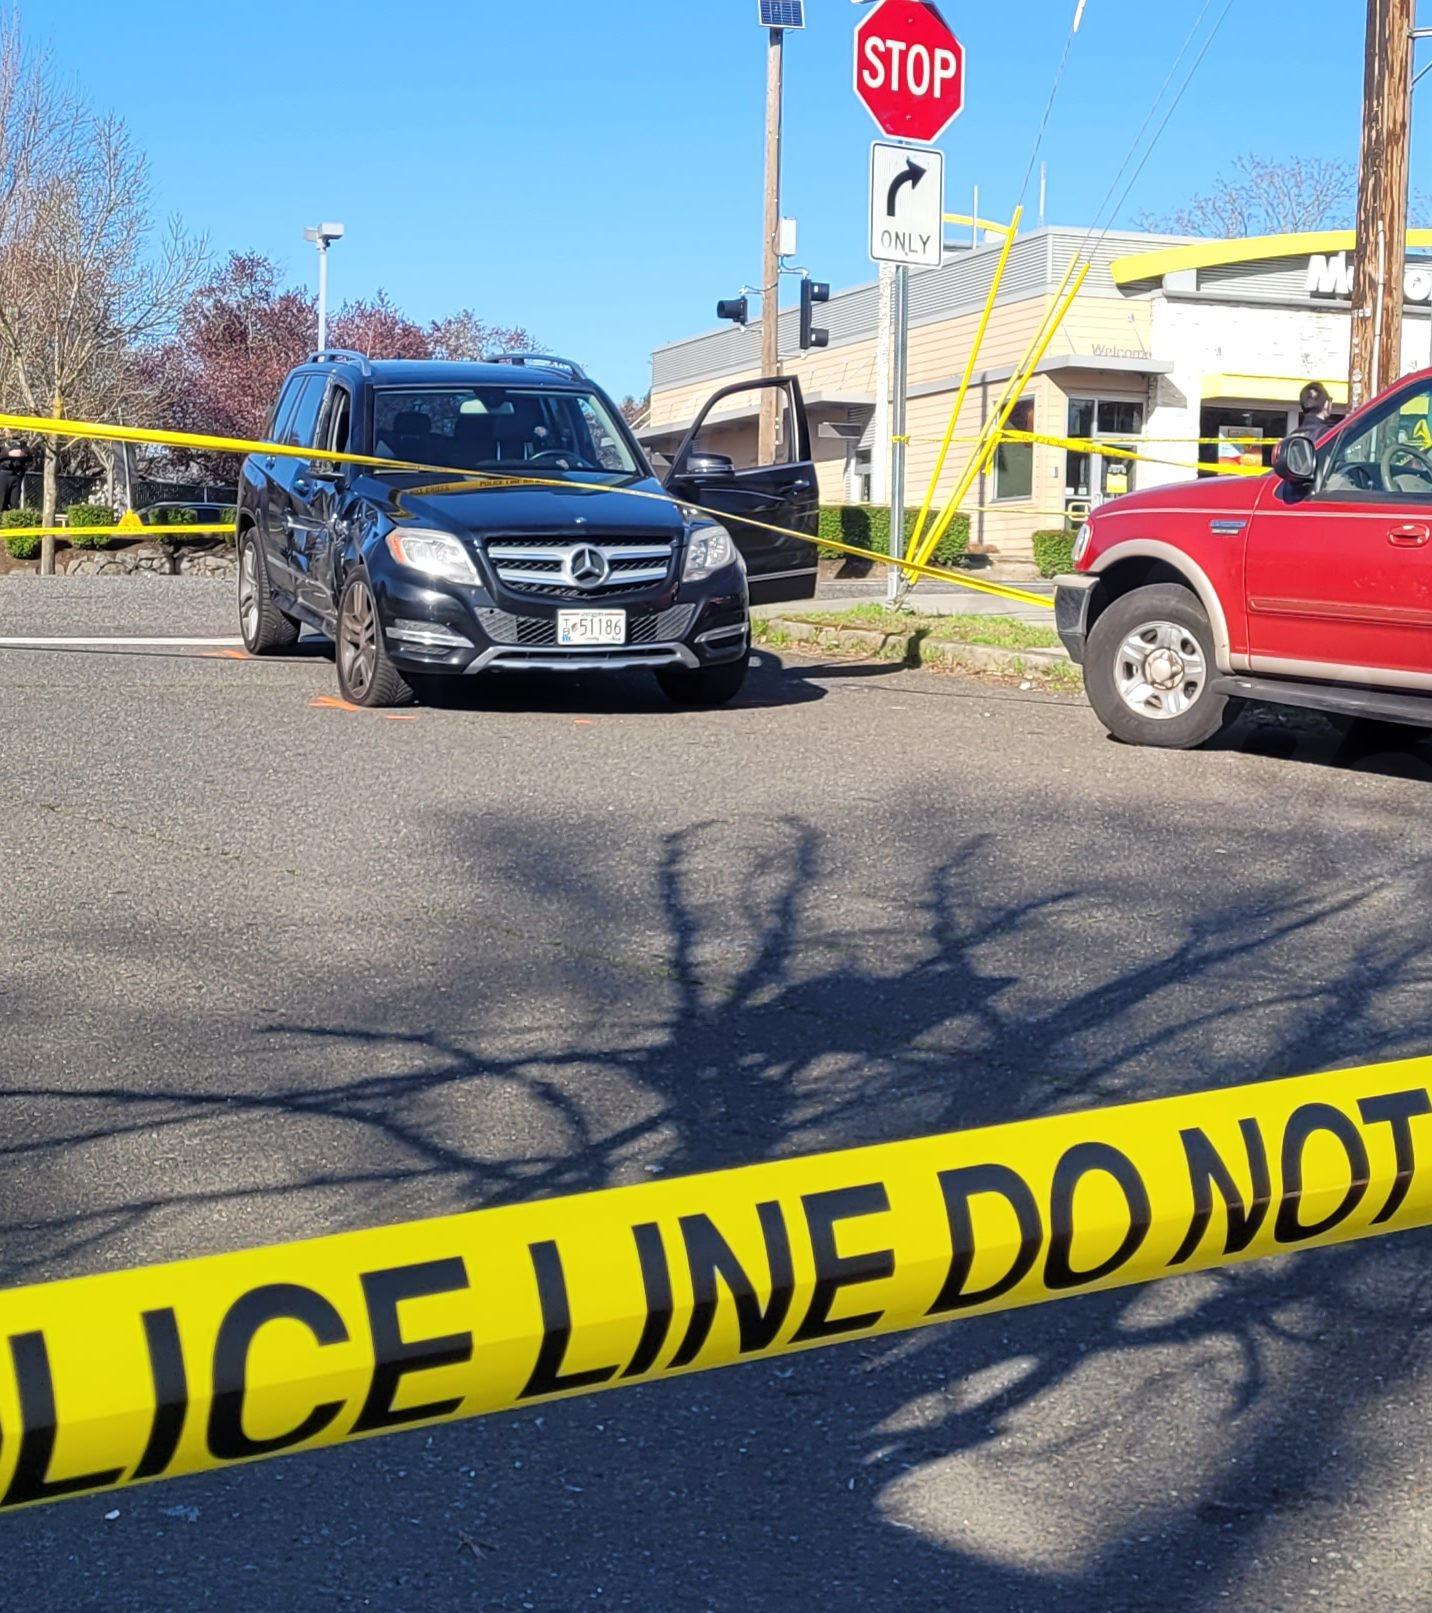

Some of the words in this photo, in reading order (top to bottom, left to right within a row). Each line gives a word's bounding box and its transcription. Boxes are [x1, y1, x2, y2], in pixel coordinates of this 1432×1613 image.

[862, 36, 957, 99] STOP
[881, 230, 931, 255] ONLY
[579, 618, 622, 636] 51186
[0, 1257, 475, 1506] LICE
[518, 1183, 896, 1400] LINE
[924, 1141, 1152, 1316] DO
[1167, 1089, 1431, 1266] NOT
